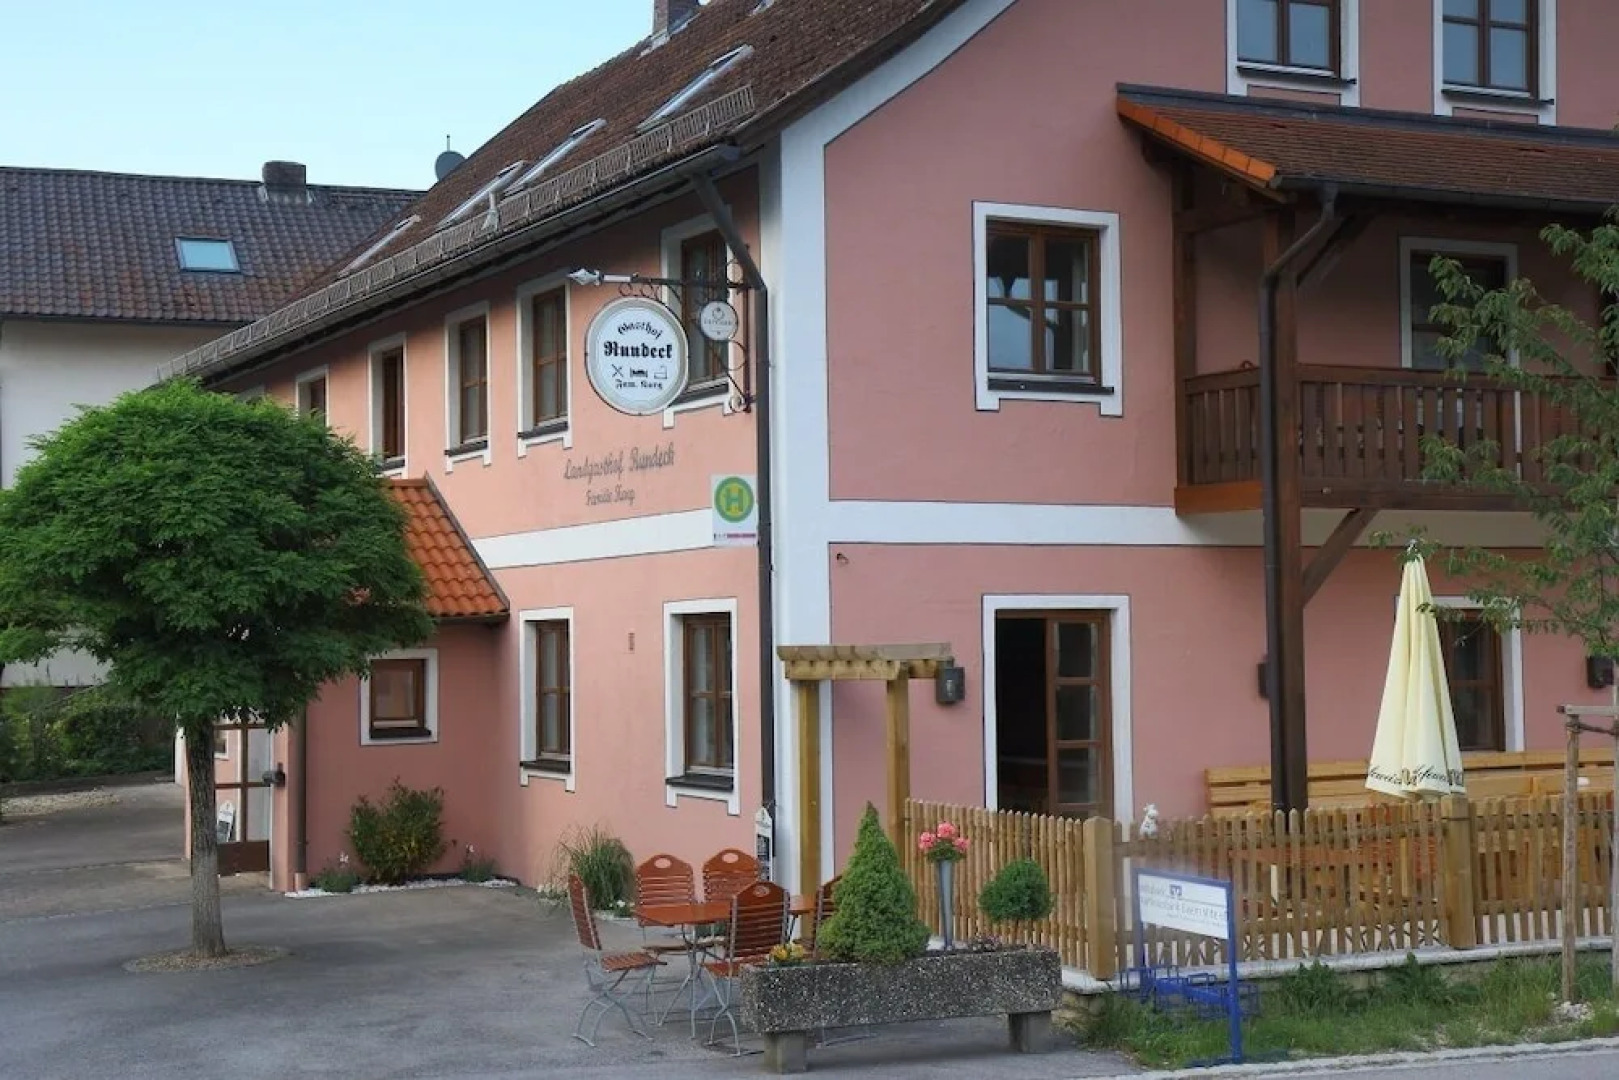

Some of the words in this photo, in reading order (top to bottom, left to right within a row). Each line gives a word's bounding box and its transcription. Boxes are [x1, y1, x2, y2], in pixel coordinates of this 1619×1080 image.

[603, 340, 673, 359] Rundeck
[563, 450, 624, 484] Landgasthof
[629, 441, 675, 472] Rundeck
[725, 487, 744, 512] H
